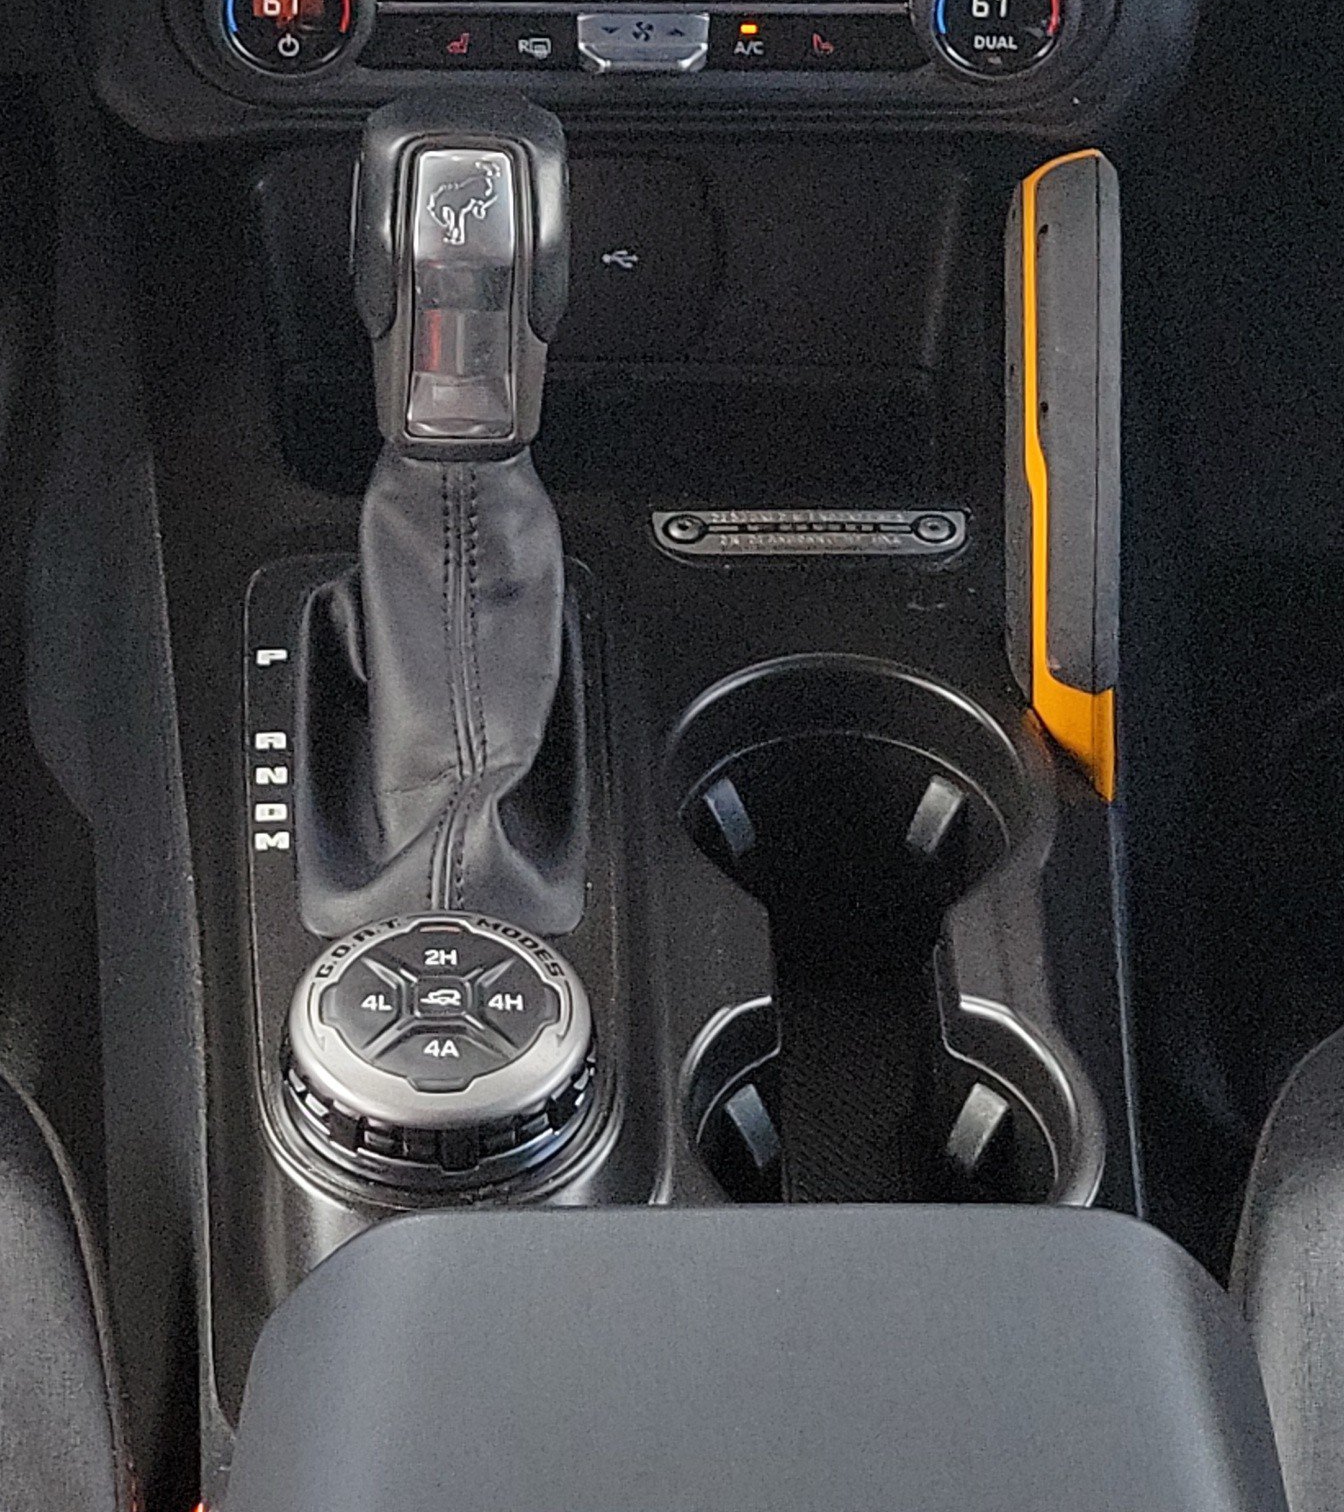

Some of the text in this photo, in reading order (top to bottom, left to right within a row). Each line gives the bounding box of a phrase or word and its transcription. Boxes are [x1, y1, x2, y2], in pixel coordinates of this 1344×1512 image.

[734, 41, 764, 56] A/C
[974, 35, 1017, 51] DUAL
[256, 649, 288, 666] P
[255, 732, 287, 750] R
[255, 766, 288, 784] N
[255, 803, 288, 822] D
[255, 831, 290, 851] M
[476, 916, 565, 980] MODES
[424, 949, 457, 965] 2H
[361, 994, 392, 1011] 4L
[488, 993, 524, 1011] 4H
[423, 1040, 459, 1057] 4A
